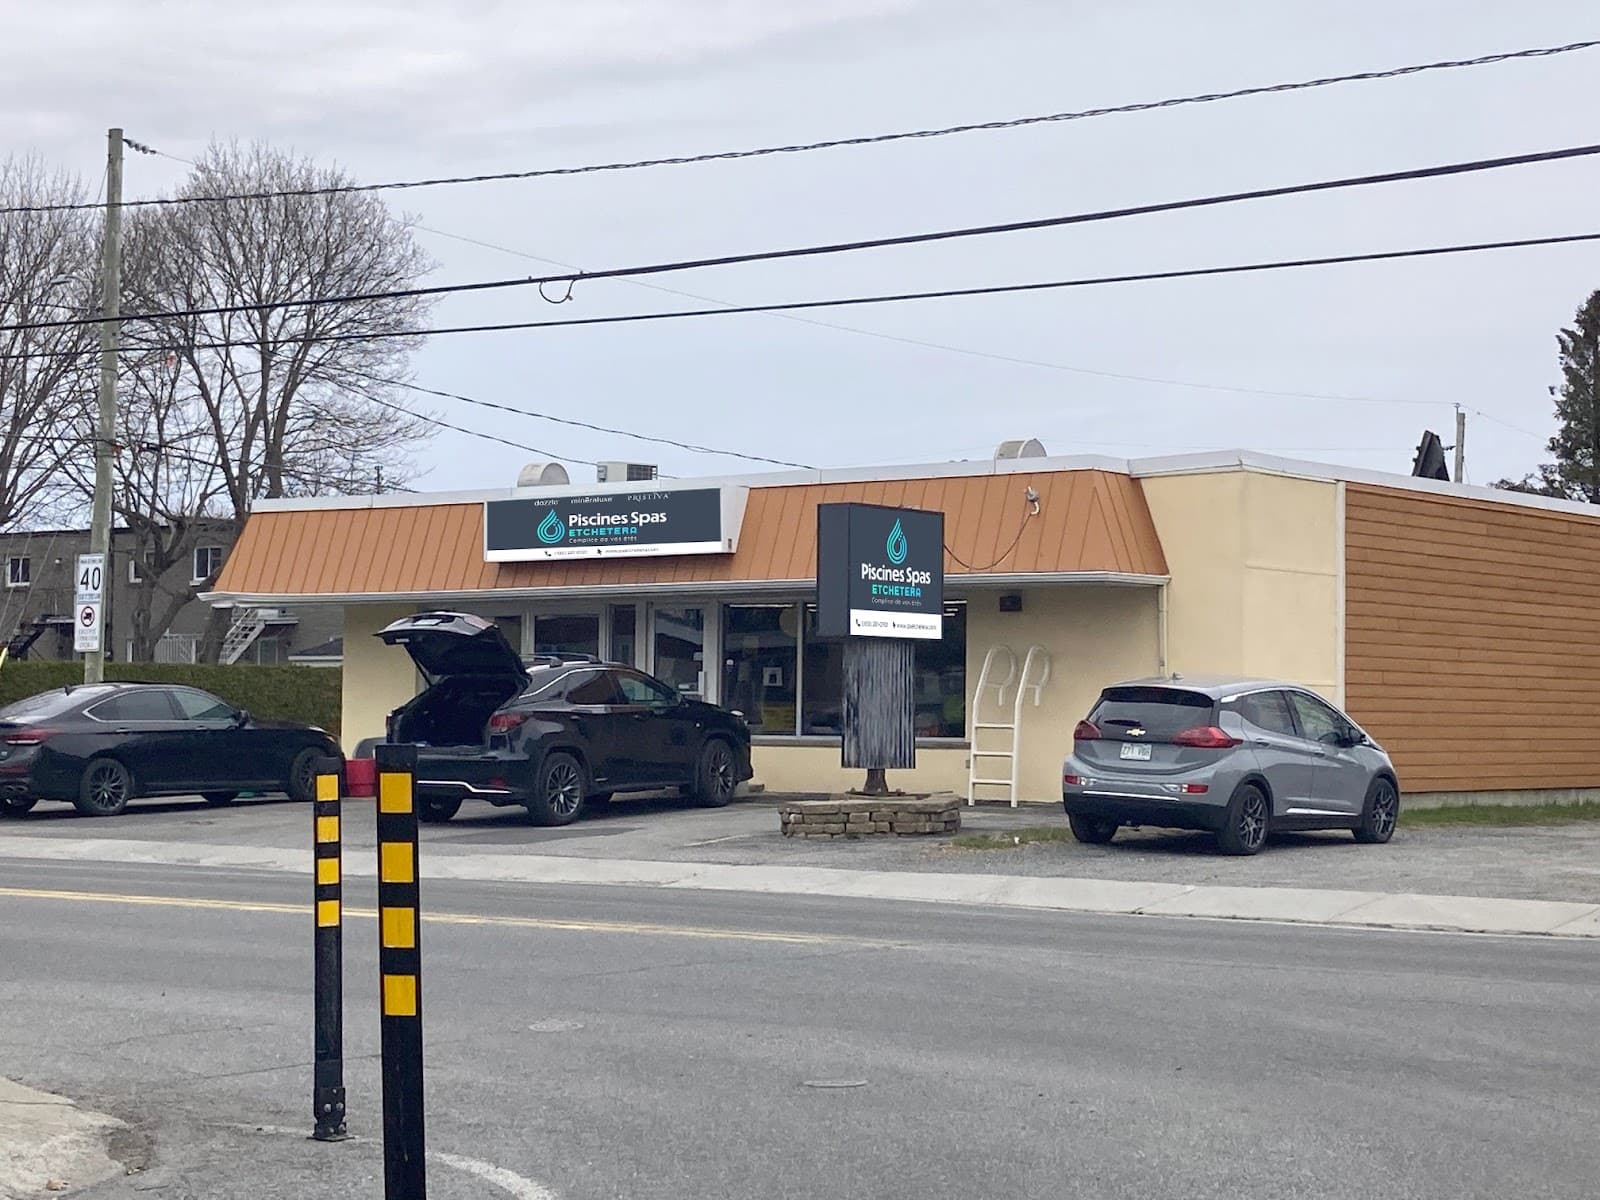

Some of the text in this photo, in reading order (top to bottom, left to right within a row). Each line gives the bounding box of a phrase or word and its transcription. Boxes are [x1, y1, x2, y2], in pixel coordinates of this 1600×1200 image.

[568, 511, 667, 527] Piscines Spas
[568, 526, 638, 537] ETCHETERA
[80, 567, 101, 591] 40
[861, 563, 931, 586] Piscines Spas
[871, 584, 922, 598] ETCHETERA
